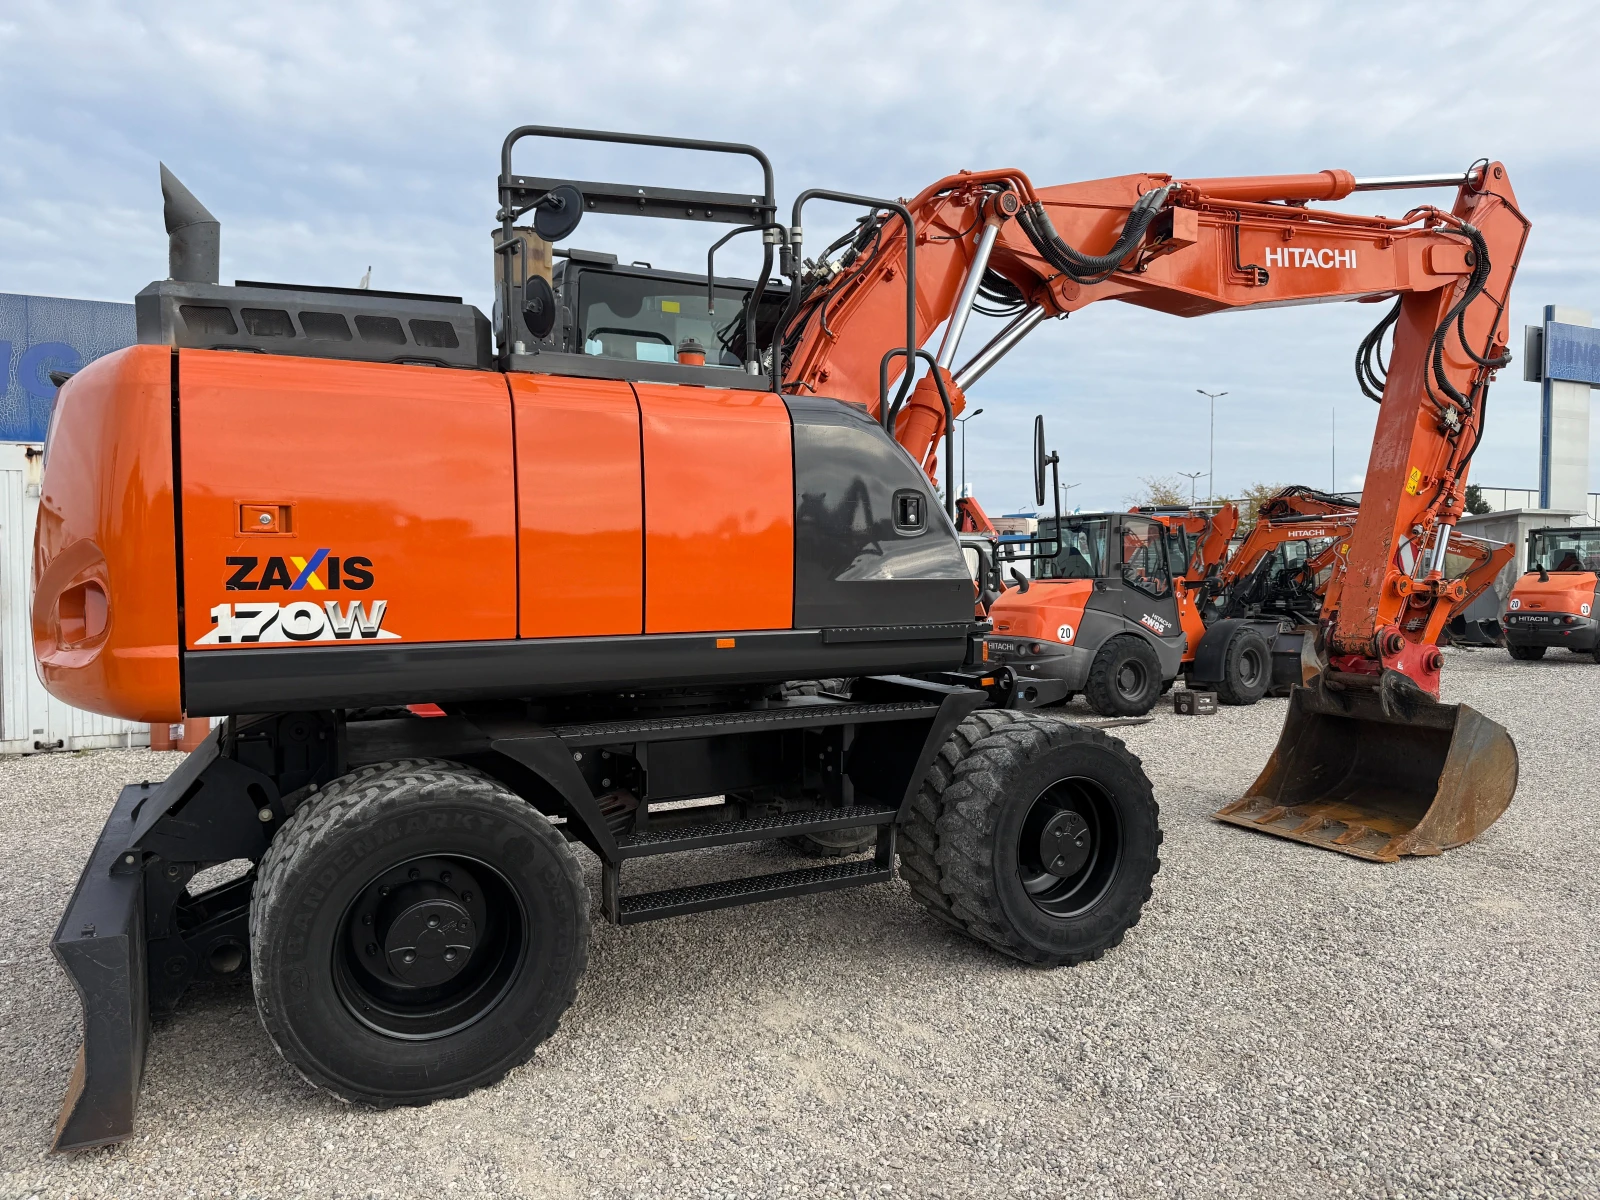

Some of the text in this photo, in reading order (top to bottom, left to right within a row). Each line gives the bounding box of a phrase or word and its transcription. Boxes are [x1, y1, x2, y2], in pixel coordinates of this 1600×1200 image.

[1265, 246, 1357, 269] HITACHI
[1288, 529, 1325, 538] HITACHI
[225, 548, 375, 591] ZAXIS
[1511, 600, 1519, 608] 20
[1582, 605, 1589, 614] 20
[210, 599, 388, 643] 170W
[1141, 613, 1165, 633] ZW95
[1151, 612, 1173, 629] HITACHI
[1060, 627, 1071, 639] 20
[988, 642, 1014, 651] HITACHI
[285, 812, 494, 957] BANDENMARKT
